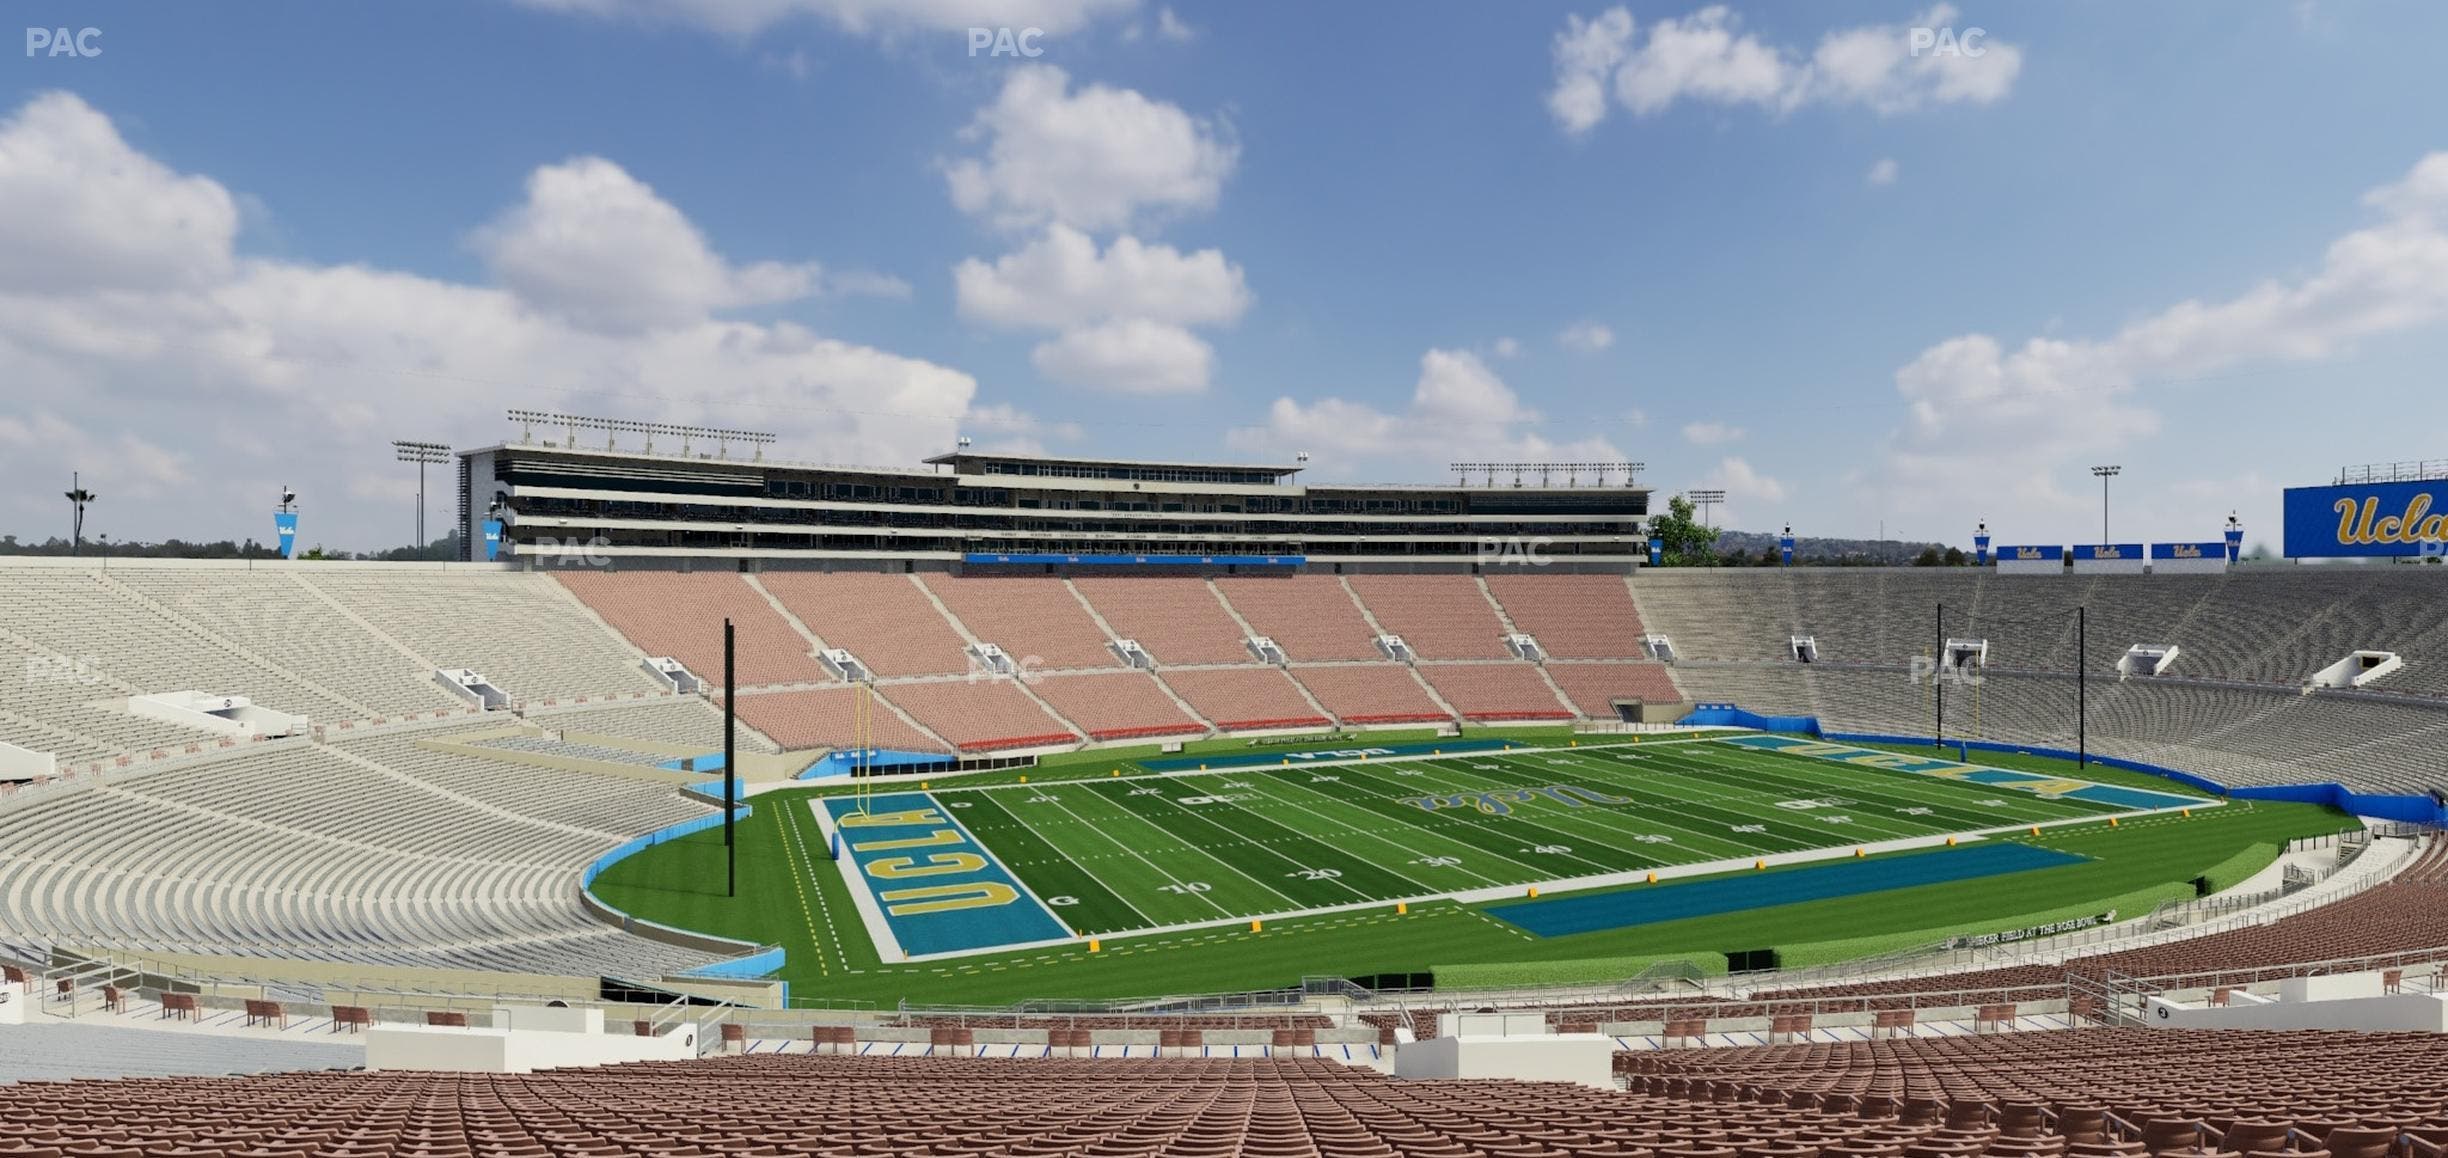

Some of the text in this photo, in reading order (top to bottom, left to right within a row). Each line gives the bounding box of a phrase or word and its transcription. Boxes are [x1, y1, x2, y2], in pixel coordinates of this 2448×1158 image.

[2334, 493, 2448, 545] Ucla
[839, 808, 1021, 917] UCLA
[1297, 868, 1343, 880] 20
[1163, 881, 1212, 895] 10
[1047, 896, 1079, 906] G
[2000, 930, 2025, 942] FIELD
[2026, 927, 2037, 938] AT
[2039, 924, 2055, 936] THE
[2056, 919, 2076, 931] ROSE
[2076, 916, 2097, 928] BOWL
